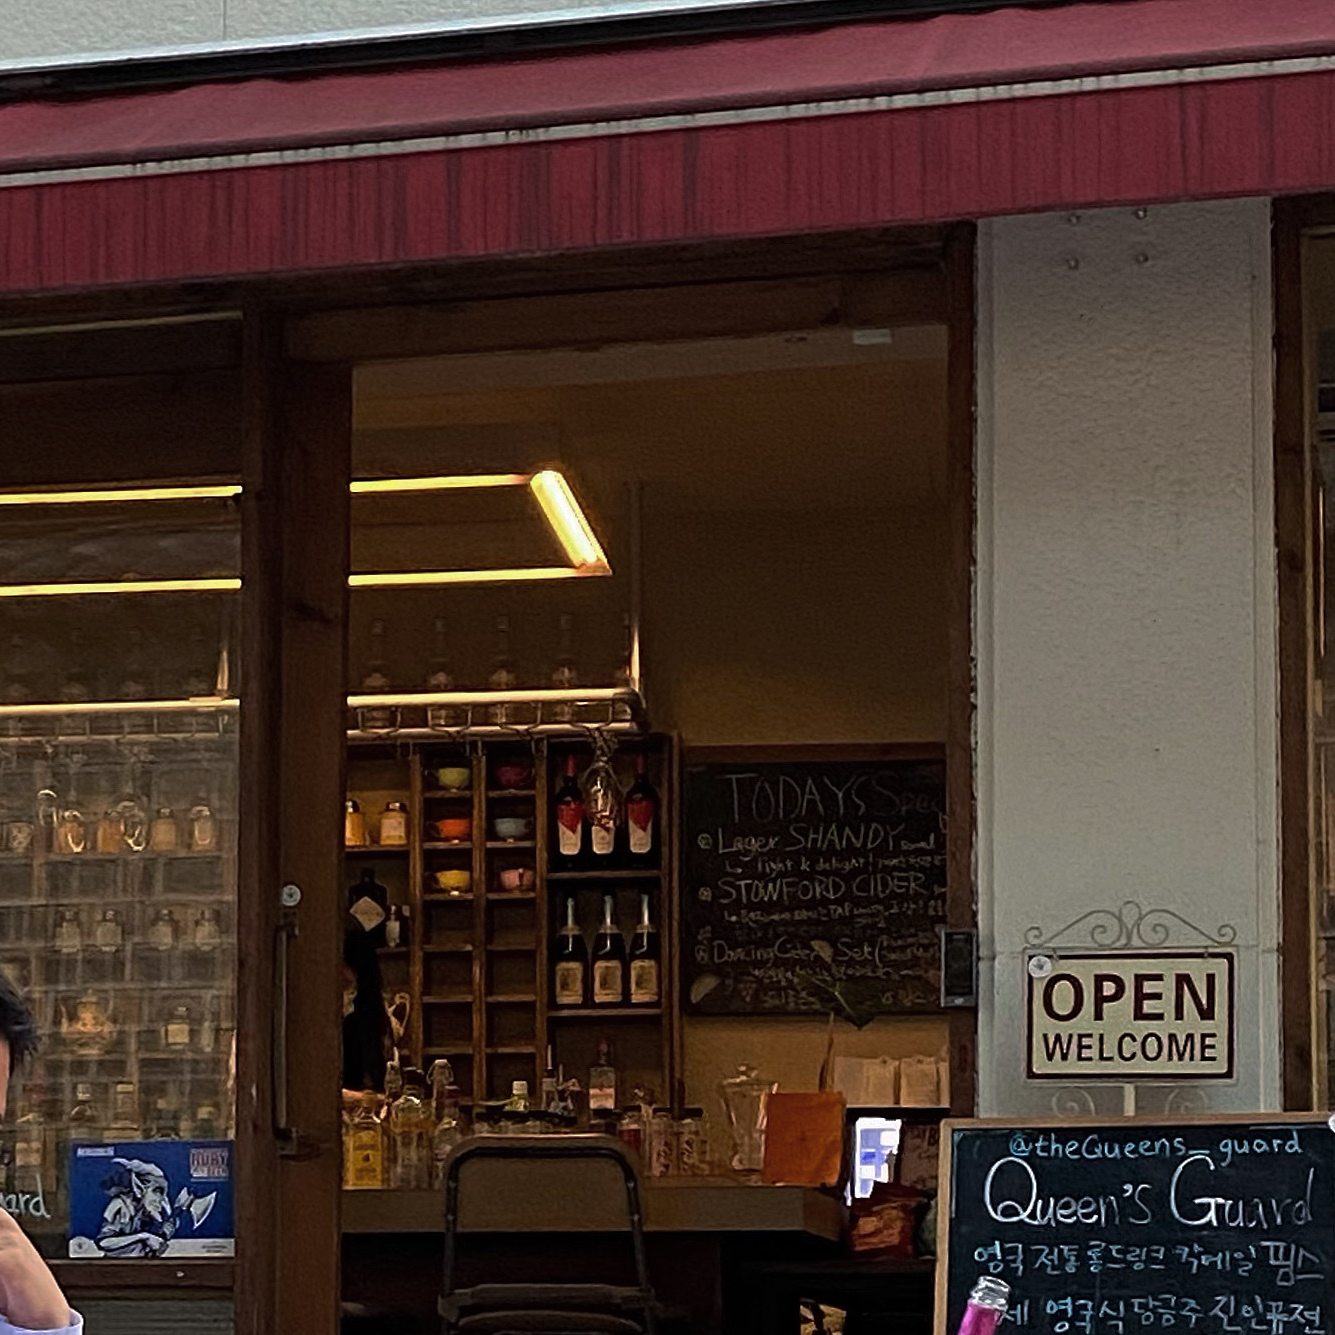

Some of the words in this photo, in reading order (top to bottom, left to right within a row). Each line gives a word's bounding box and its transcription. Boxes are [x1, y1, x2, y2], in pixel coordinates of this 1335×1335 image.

[785, 822, 905, 852] SHANDY
[852, 871, 930, 899] CIDER
[1042, 972, 1216, 1022] OPEN
[1042, 1032, 1218, 1062] WELCOME
[1169, 1154, 1316, 1230] Guard
[1044, 1295, 1126, 1335] 영국식
